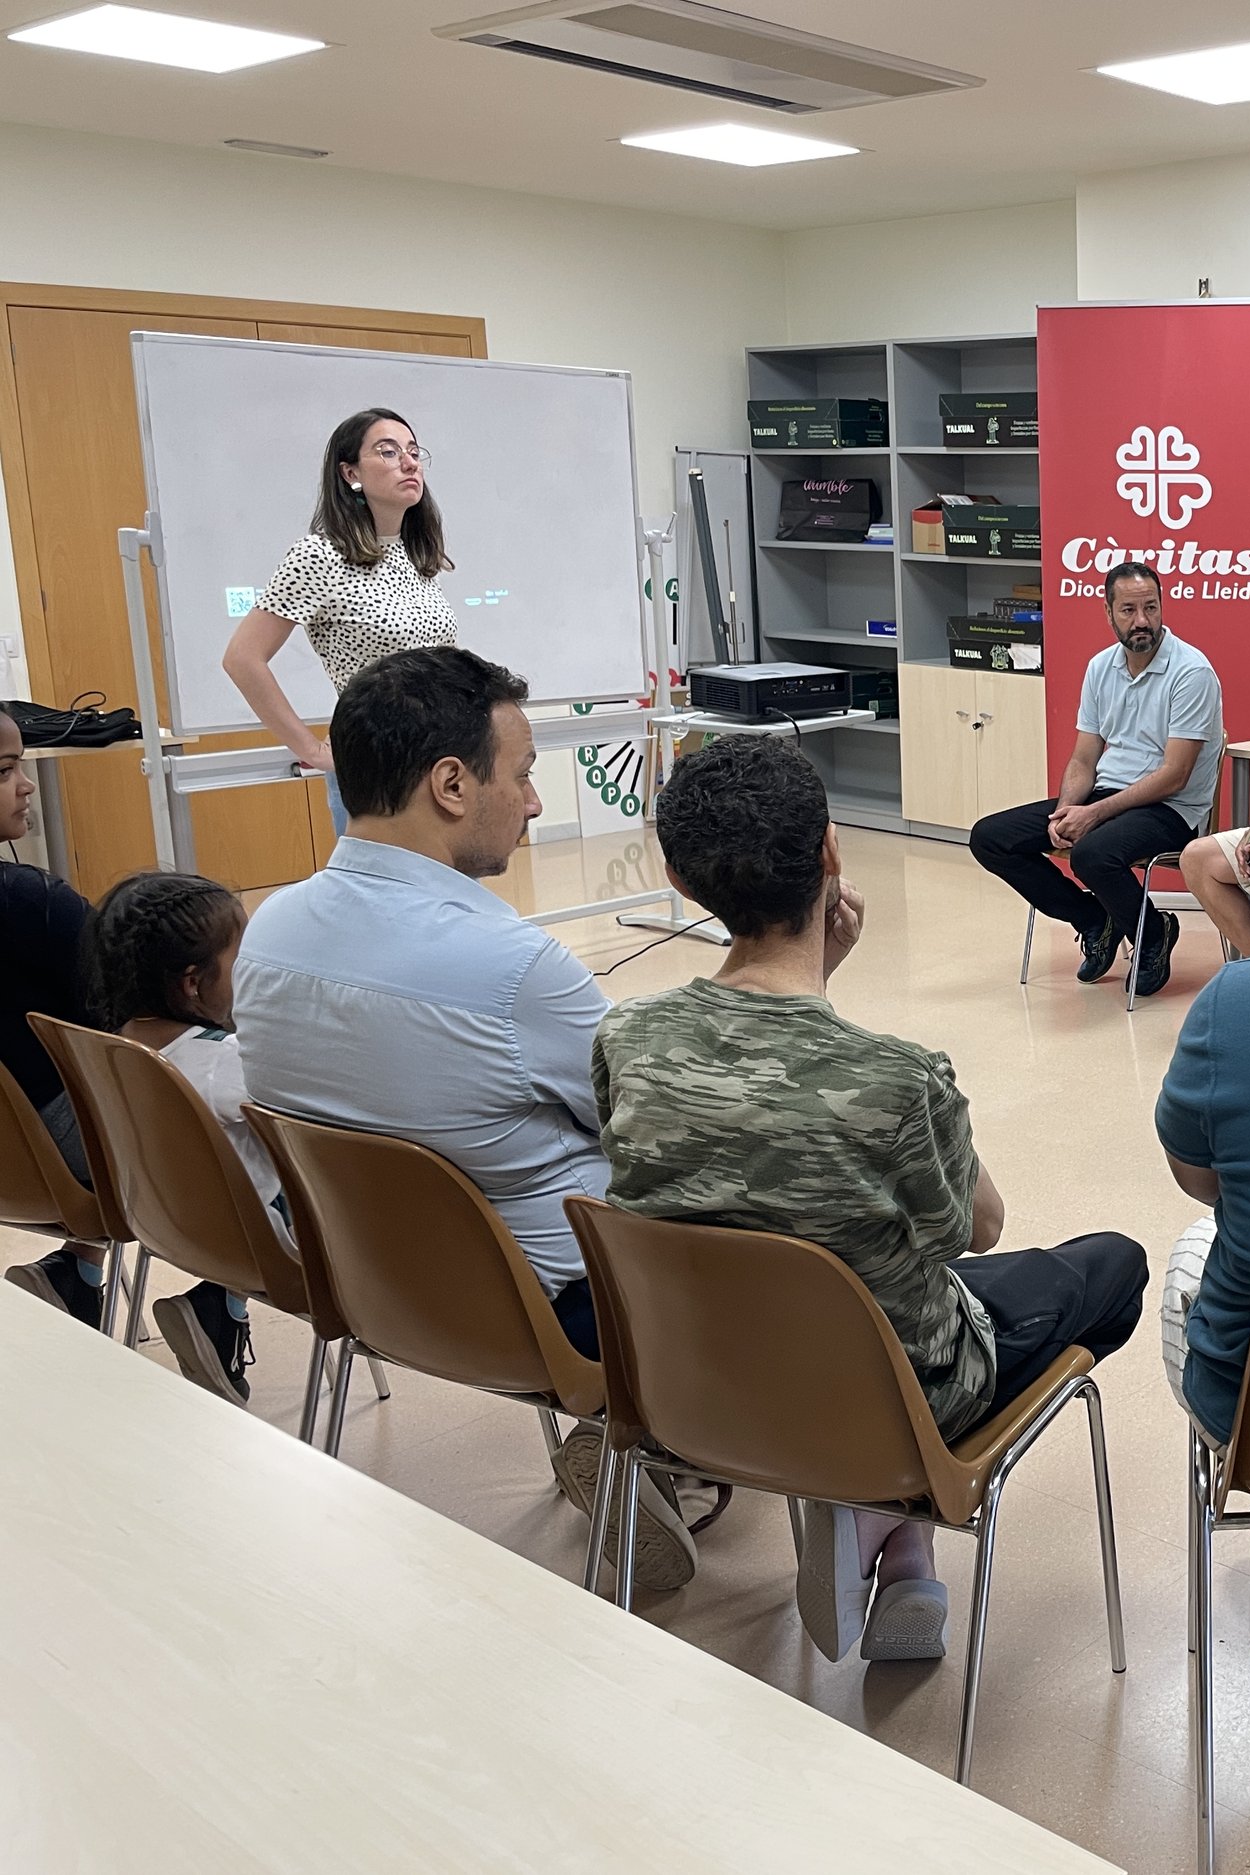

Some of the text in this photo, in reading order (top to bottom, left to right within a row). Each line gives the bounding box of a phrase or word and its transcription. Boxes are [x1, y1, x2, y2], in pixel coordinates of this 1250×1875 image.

[753, 427, 778, 436] TALKUAL
[946, 424, 975, 434] TALKUAL
[948, 534, 977, 544] TALKUAL
[1170, 580, 1195, 599] de
[954, 648, 983, 660] TALKUAL
[584, 747, 594, 763] R
[592, 769, 602, 784] Q
[607, 787, 617, 803] P
